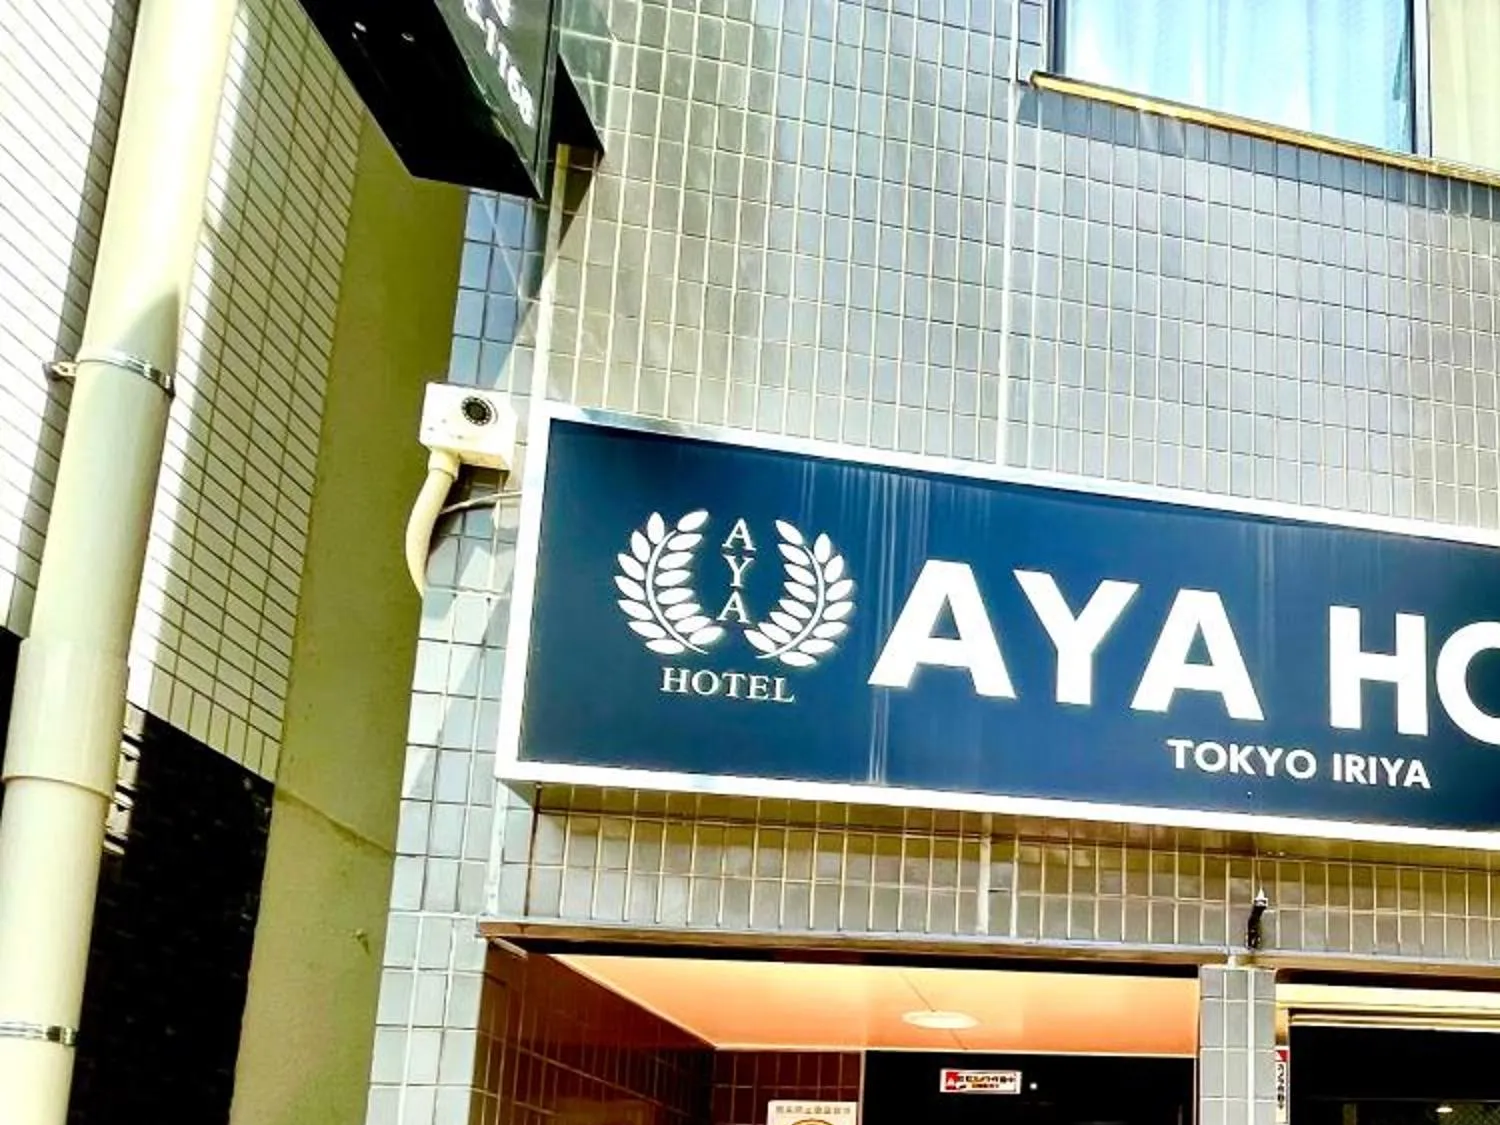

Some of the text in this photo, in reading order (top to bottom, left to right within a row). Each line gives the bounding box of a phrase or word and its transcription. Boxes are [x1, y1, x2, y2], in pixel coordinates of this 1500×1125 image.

[716, 518, 756, 624] AYA
[867, 559, 1265, 721] AYA
[660, 667, 795, 702] HOTEL
[1166, 738, 1431, 790] TOKYO IRIYA
